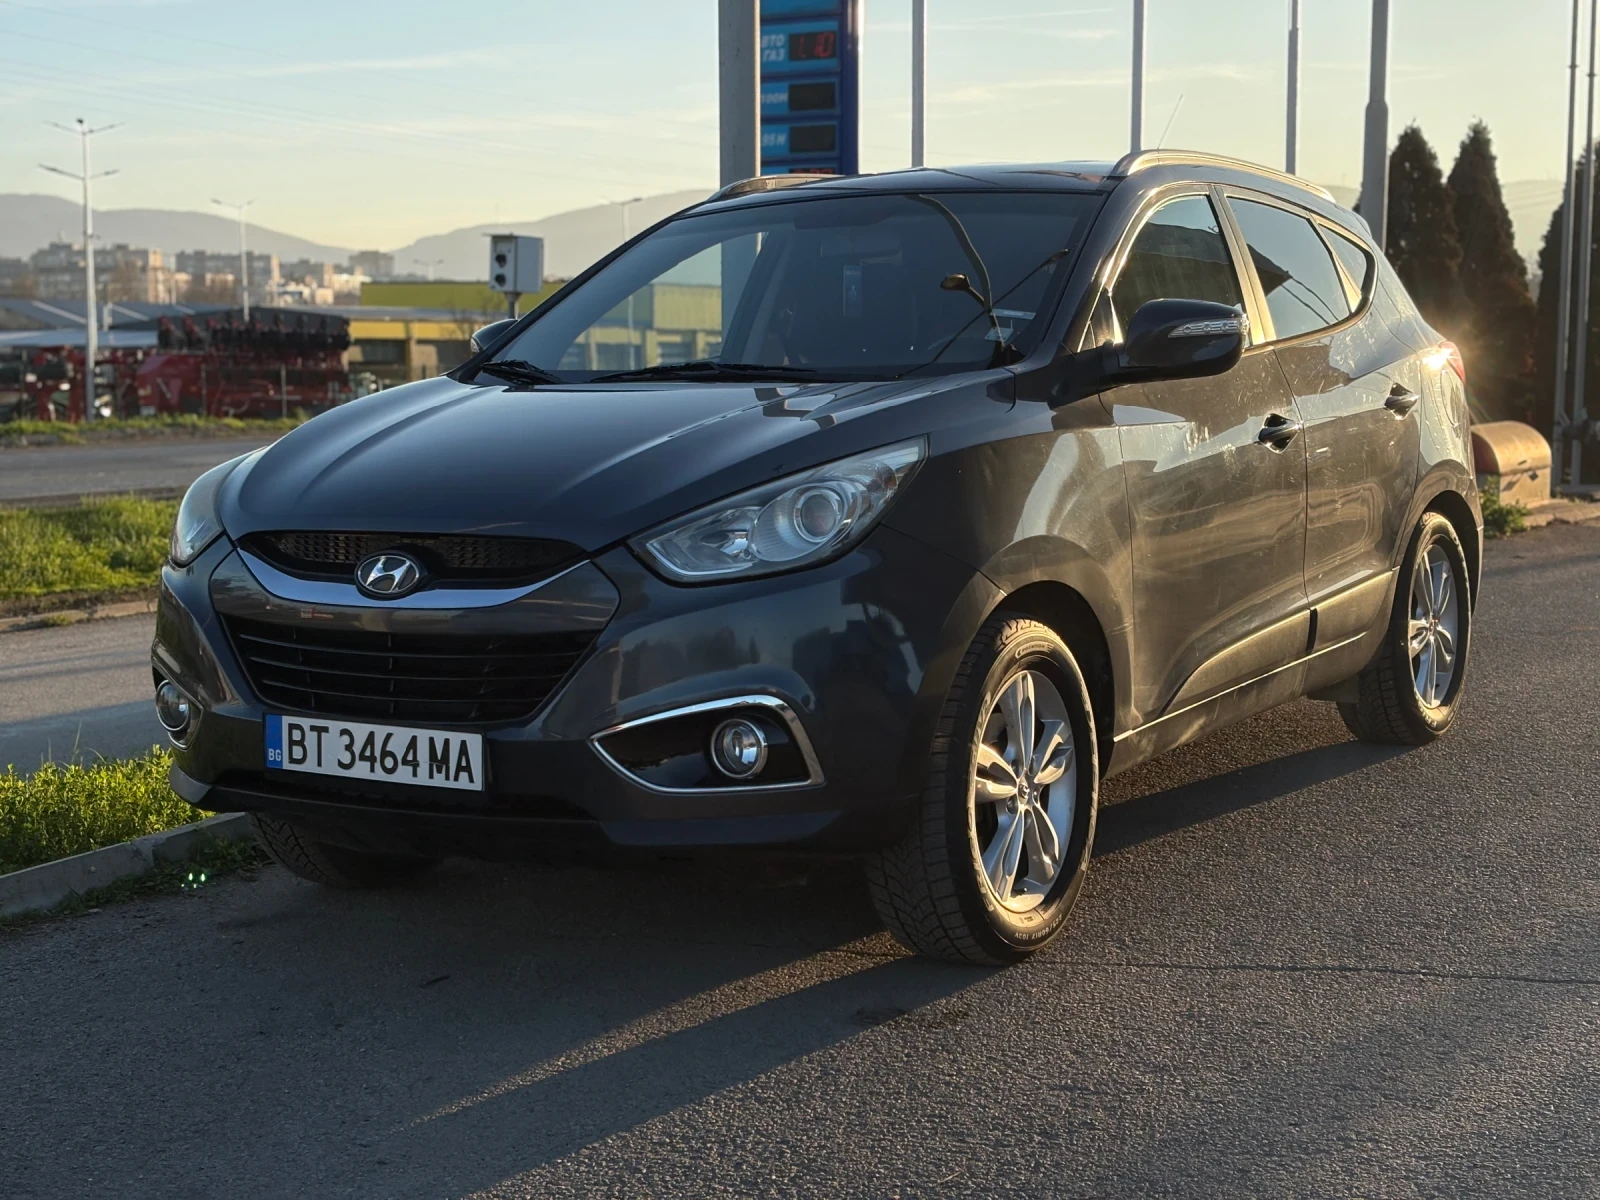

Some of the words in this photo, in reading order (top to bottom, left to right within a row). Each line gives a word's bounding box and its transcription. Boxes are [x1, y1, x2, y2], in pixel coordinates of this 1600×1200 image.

[761, 34, 785, 48] ВТО
[268, 748, 282, 761] BG
[287, 722, 330, 768] BT
[337, 728, 420, 778] 3464
[428, 736, 475, 784] MA
